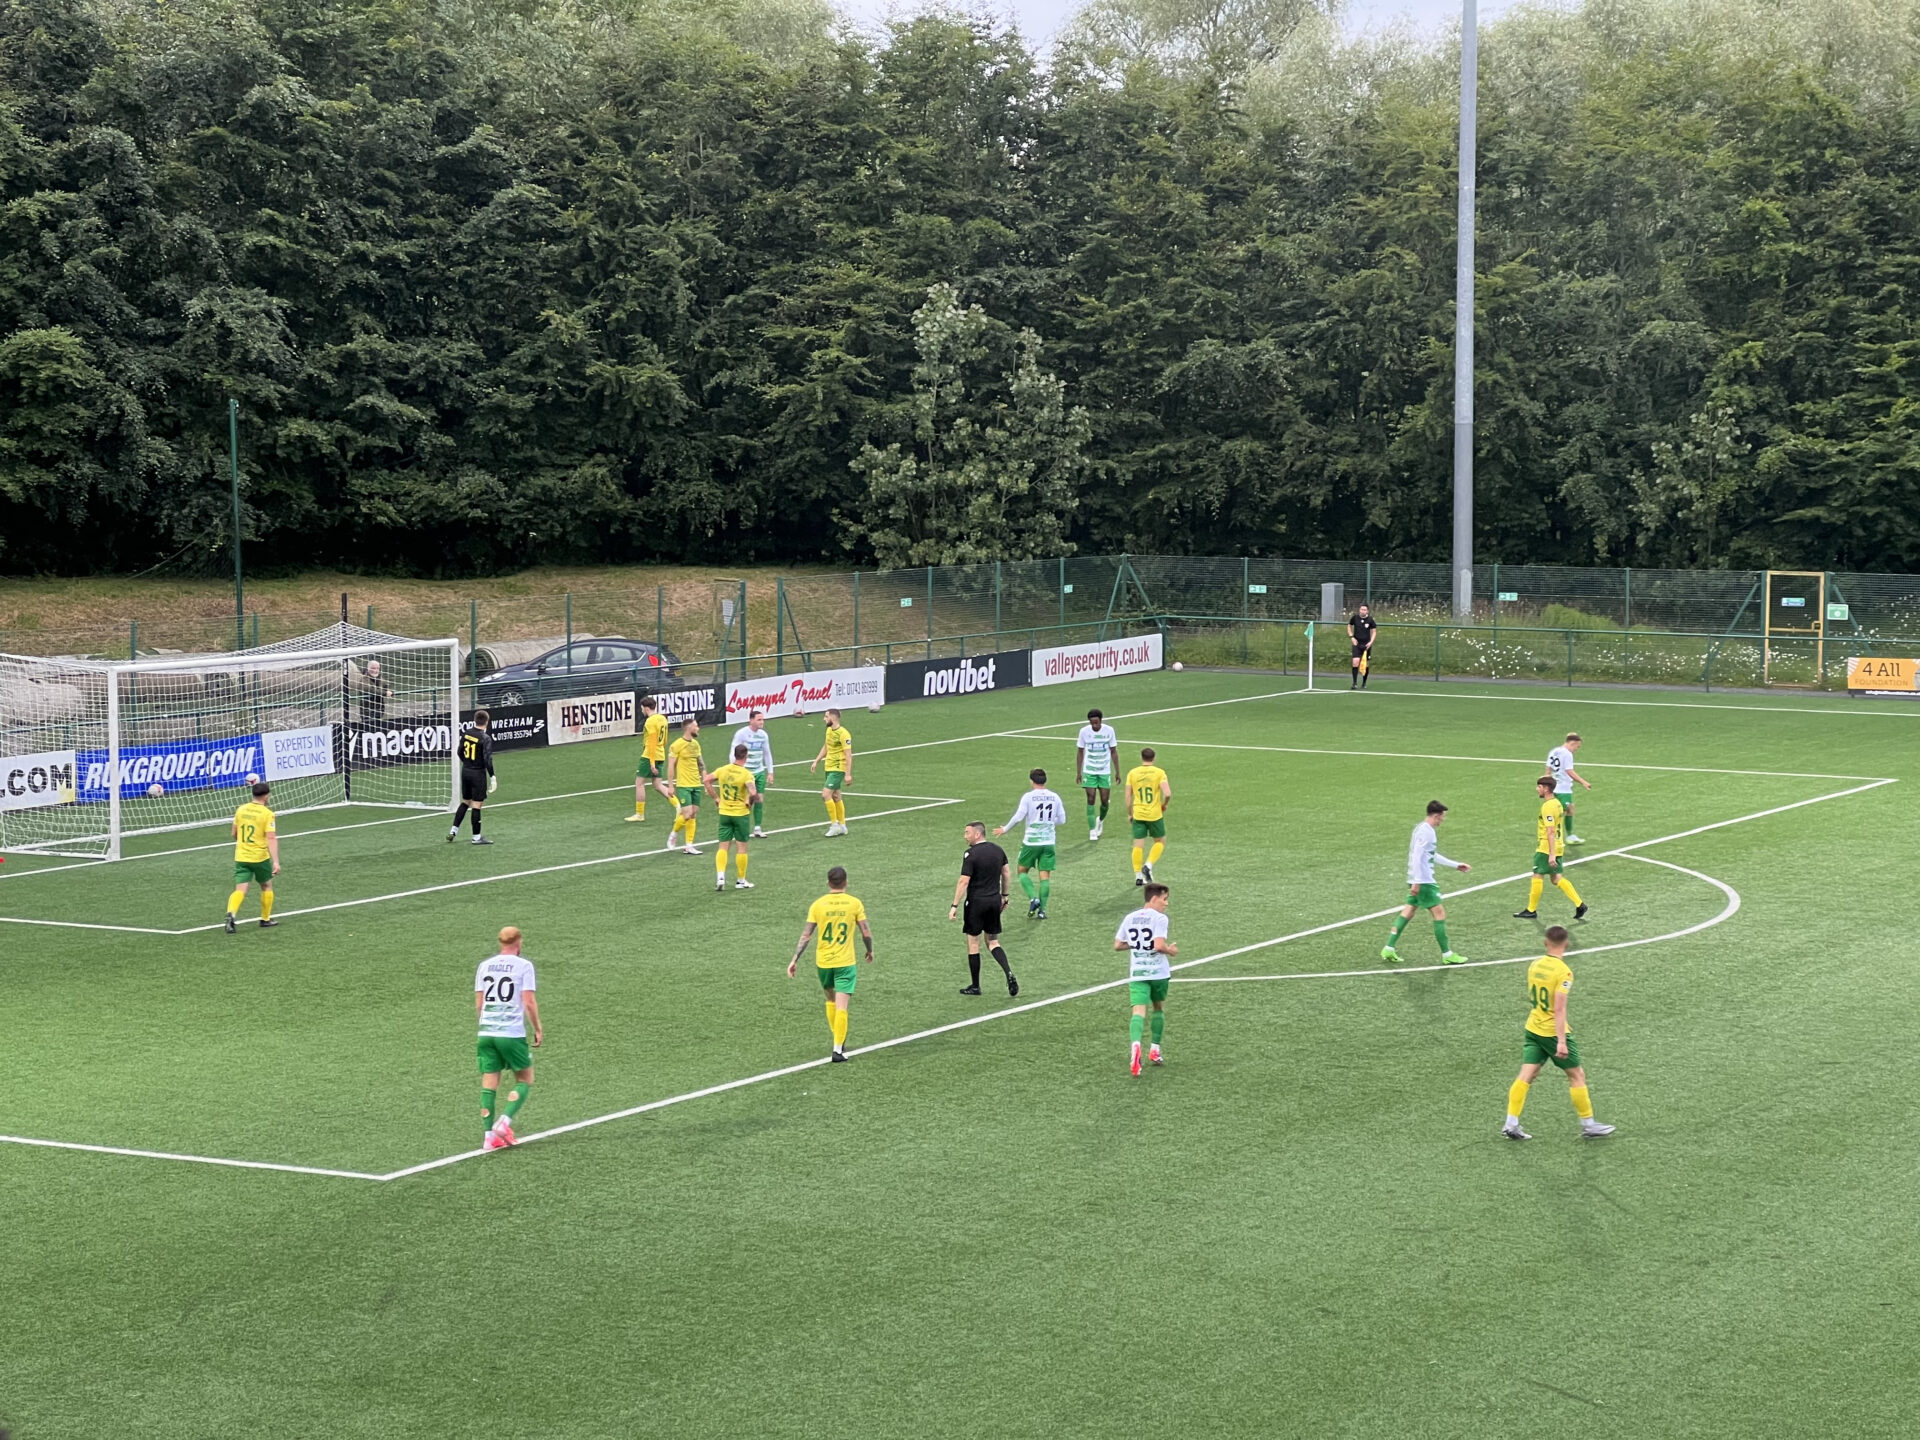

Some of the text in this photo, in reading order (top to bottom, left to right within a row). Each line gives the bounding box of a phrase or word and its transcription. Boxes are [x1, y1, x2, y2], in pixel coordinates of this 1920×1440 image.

[1045, 641, 1150, 679] valleysecurity.co.uk
[1862, 662, 1901, 677] 4 All
[923, 657, 996, 696] novibet
[726, 684, 788, 713] Longmynd
[791, 679, 833, 704] Travel
[835, 683, 846, 697] Tel:
[491, 716, 533, 730] WREXHAM
[561, 699, 632, 728] HENSTONE
[582, 725, 610, 736] DISTILLERY
[274, 734, 325, 753] EXPERTS IN
[362, 725, 450, 759] macron
[463, 740, 476, 761] 31
[276, 751, 326, 771] RECYCLING
[0, 763, 72, 798] .COM
[1138, 786, 1153, 804] 16
[1035, 803, 1053, 822] 11
[240, 823, 255, 843] 12
[821, 921, 848, 945] 43
[1128, 927, 1155, 951] 33
[483, 975, 515, 1003] 20
